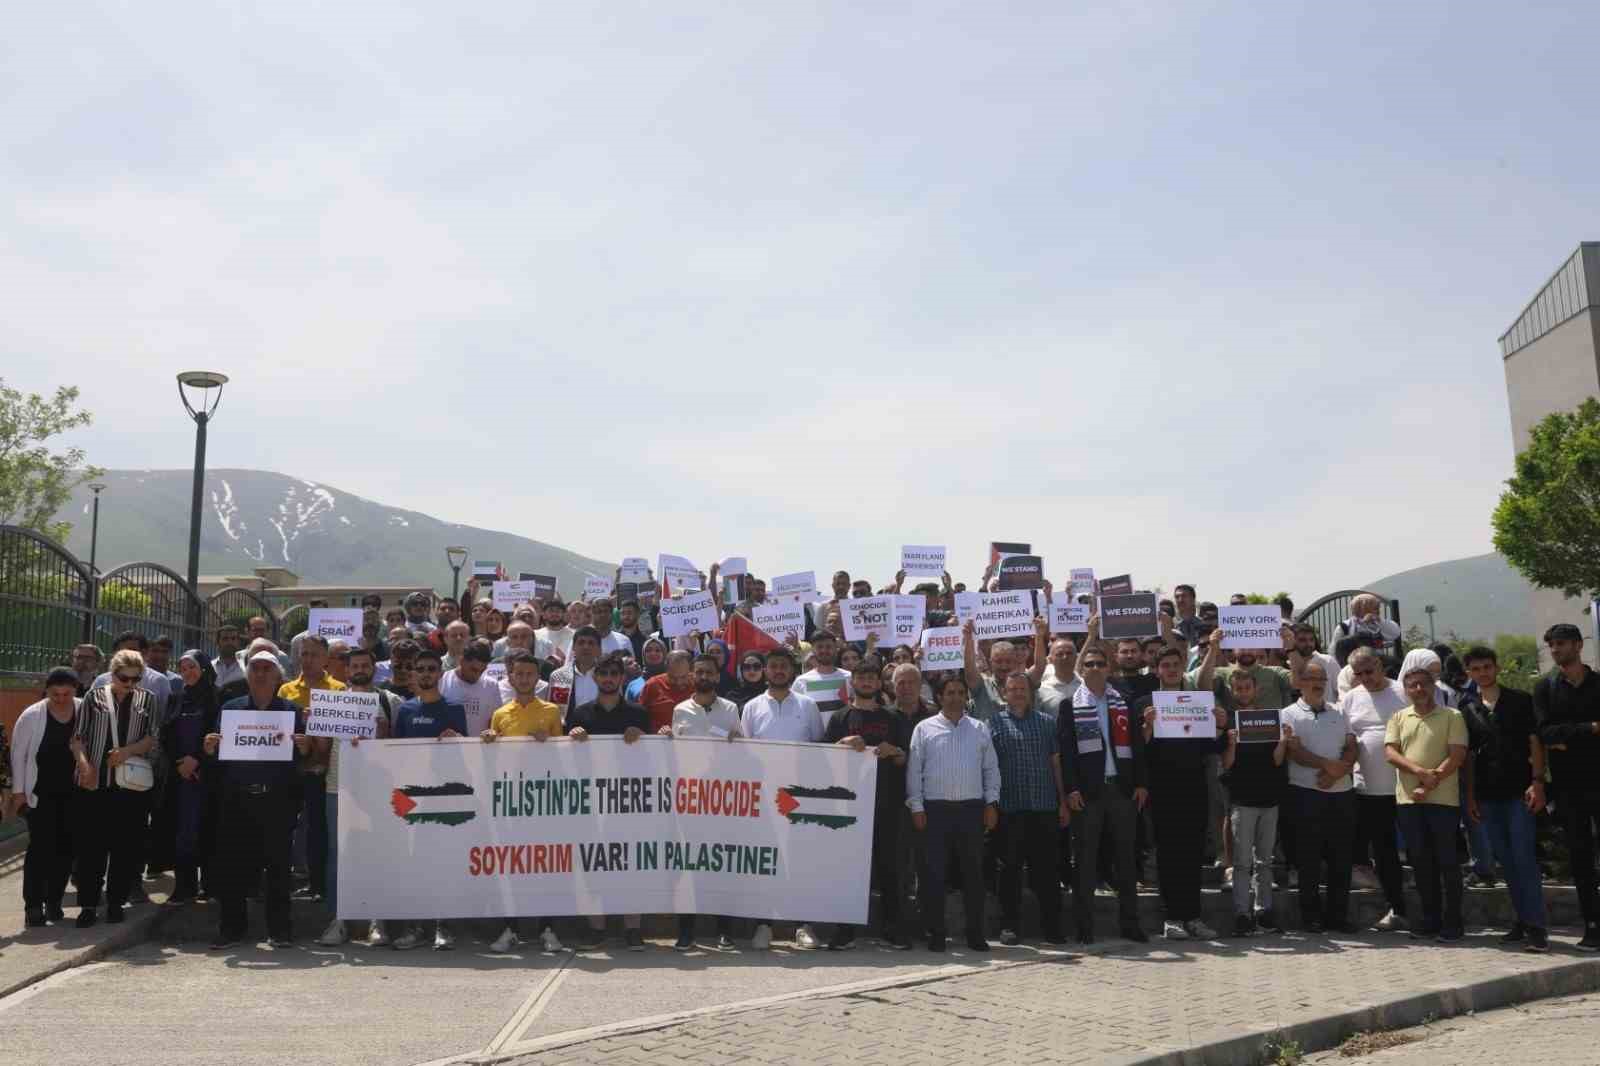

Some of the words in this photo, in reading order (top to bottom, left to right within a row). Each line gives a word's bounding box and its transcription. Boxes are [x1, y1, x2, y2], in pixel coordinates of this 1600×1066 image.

[662, 598, 714, 615] SCIENCES
[849, 601, 887, 611] GENOCIDE
[982, 595, 1022, 607] KAHIRE
[852, 614, 862, 625] IS
[863, 612, 889, 624] NOT
[975, 607, 1030, 621] AMERIKAN
[1105, 608, 1121, 616] WE
[1122, 607, 1151, 615] STAND
[683, 617, 699, 627] PO
[1222, 615, 1246, 625] NEW
[1248, 615, 1278, 624] YORK
[974, 622, 1033, 636] UNIVERSITY
[927, 635, 961, 647] FREE
[927, 651, 963, 663] GAZA
[311, 693, 377, 707] CALIFORNIA
[313, 707, 373, 721] BERKELEY
[308, 722, 375, 737] UNIVERSITY
[234, 732, 281, 747] İSRAİL
[492, 771, 591, 817] FİLİSTİN'DE
[596, 777, 653, 815] THERE
[657, 776, 672, 814] IS
[675, 777, 762, 818] GENOCIDE
[469, 843, 573, 876] SOYKIRIM
[579, 842, 629, 872] VAR!
[636, 841, 658, 870] IN
[664, 841, 779, 876] PALASTINE!
